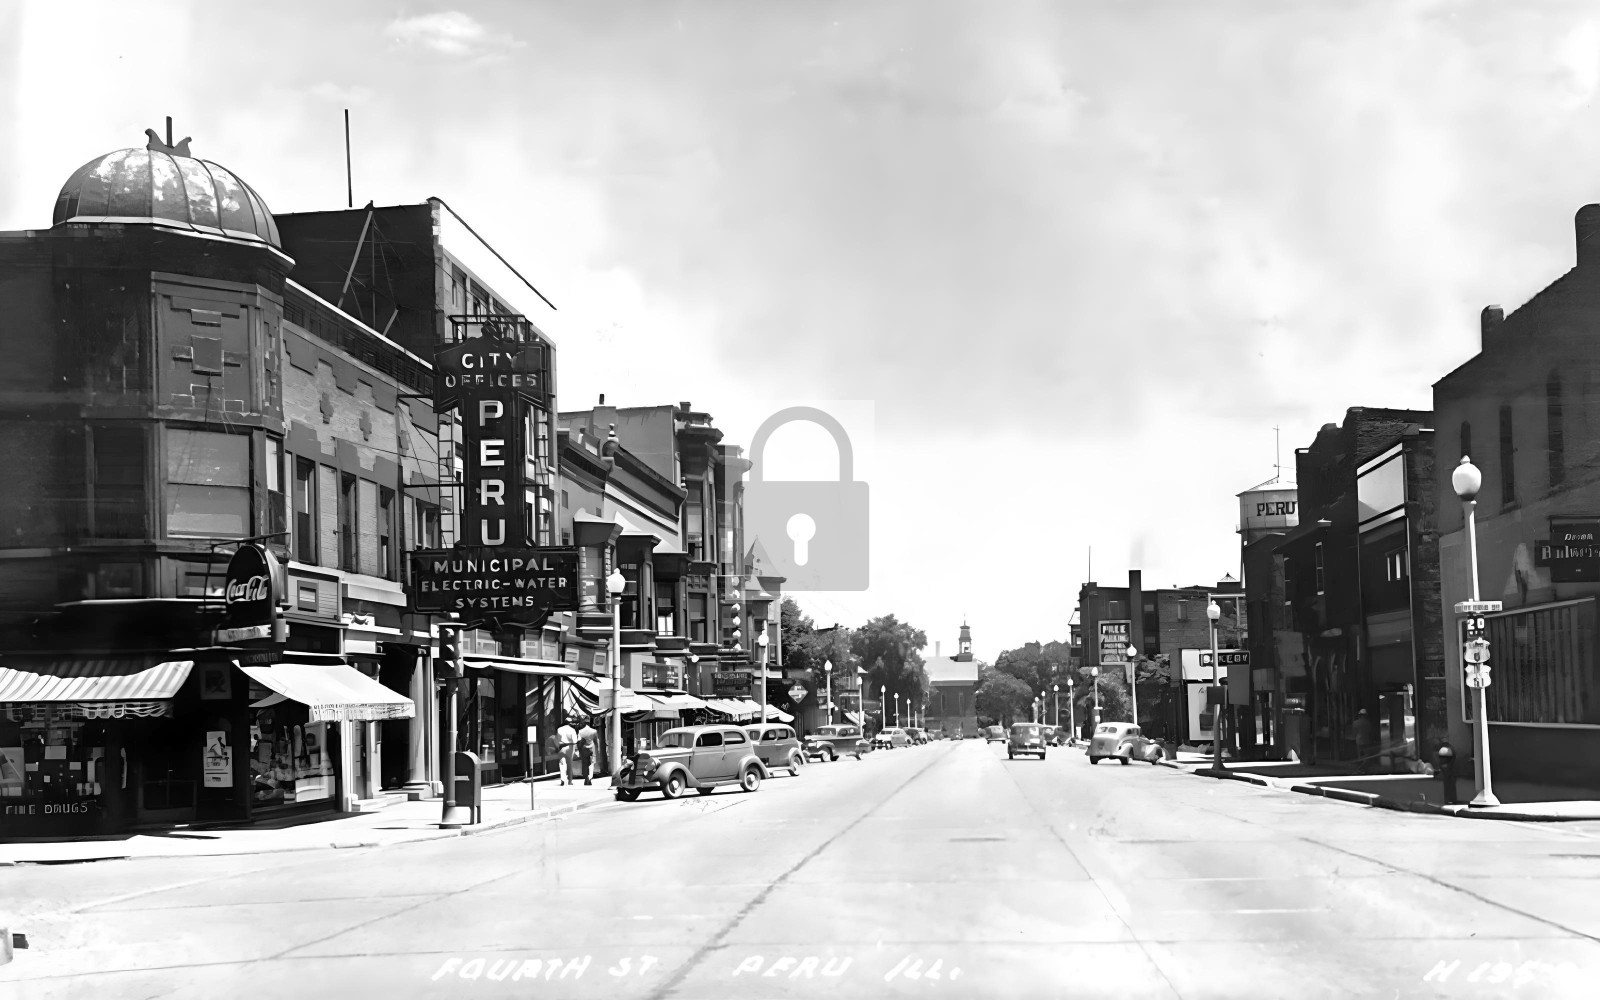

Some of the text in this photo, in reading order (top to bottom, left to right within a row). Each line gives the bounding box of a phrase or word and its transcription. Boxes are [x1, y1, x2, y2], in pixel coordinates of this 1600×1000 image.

[461, 352, 517, 369] CITY
[445, 373, 538, 388] OFFICES
[479, 400, 506, 546] PERU
[1256, 501, 1296, 517] PERU
[434, 557, 555, 574] MUNICIPAL
[421, 577, 568, 593] ELECTRIC-WATER
[1466, 618, 1485, 630] 20
[1203, 654, 1248, 664] BKERY
